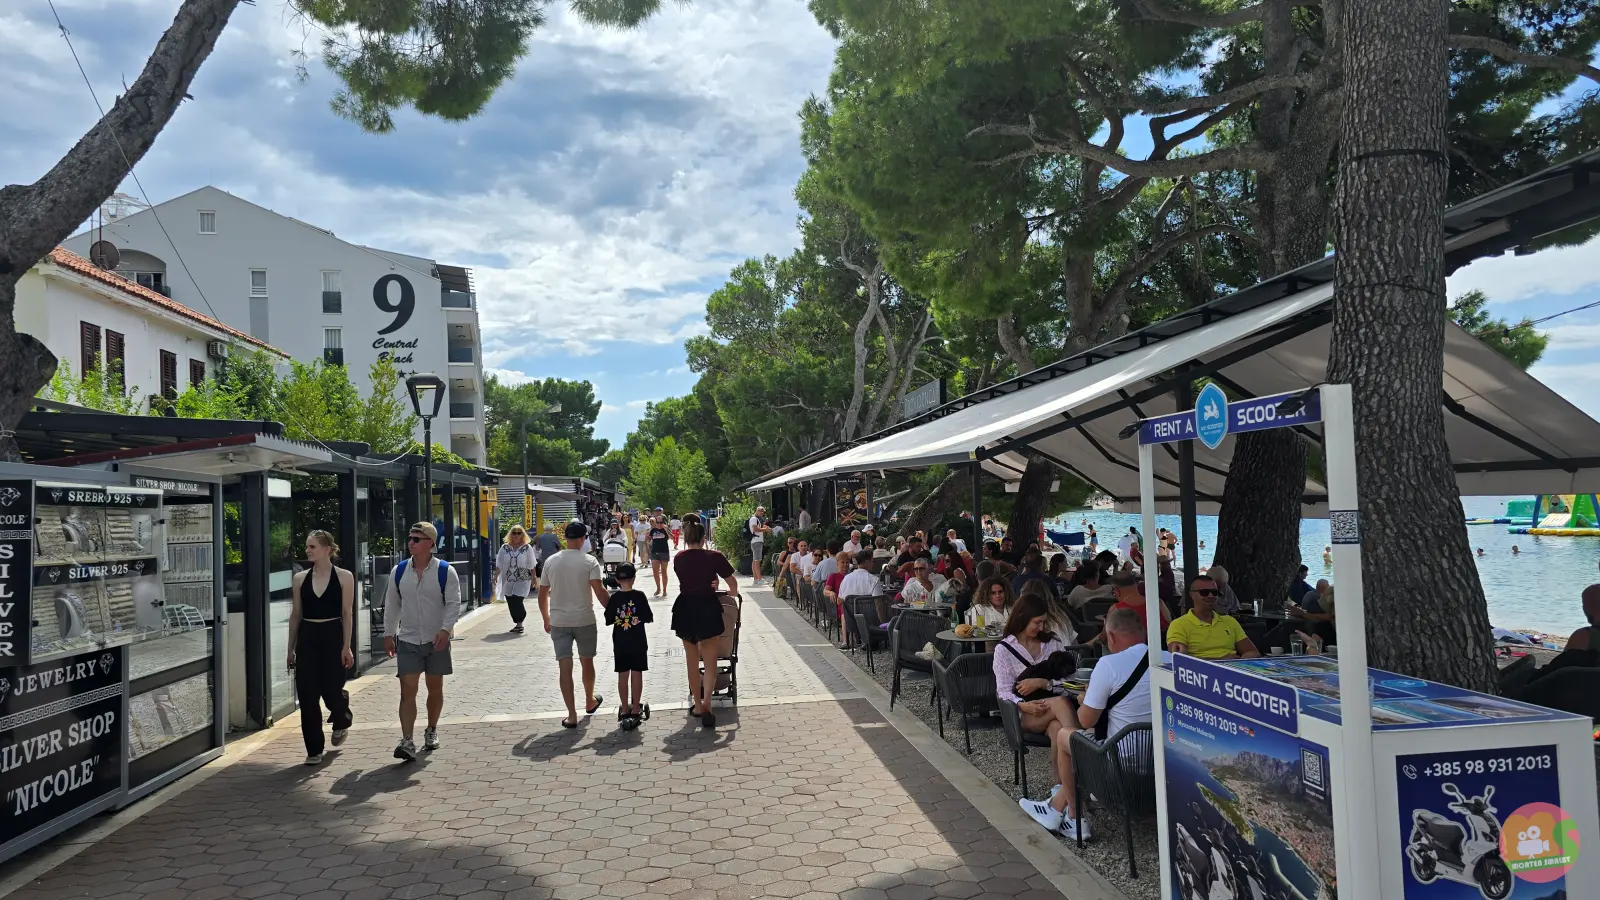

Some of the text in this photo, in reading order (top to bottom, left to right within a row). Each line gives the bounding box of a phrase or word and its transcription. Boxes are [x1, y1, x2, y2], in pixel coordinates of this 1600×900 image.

[373, 273, 416, 336] 9
[372, 337, 419, 349] Central
[378, 351, 414, 364] Bach
[1154, 397, 1306, 438] RENT A SCOOR
[67, 490, 133, 504] SREBRO 925
[135, 478, 159, 490] SILVER
[159, 480, 176, 491] SHOP
[68, 563, 129, 580] SILVER 925
[14, 660, 97, 696] JEWELRY
[1178, 667, 1289, 718] RENT A SCOOTER
[68, 711, 115, 747] SHOP
[1175, 702, 1238, 736] +385 98 931 2013
[1424, 754, 1551, 777] +385 98 931 2013
[7, 754, 100, 817] "NICOLE"
